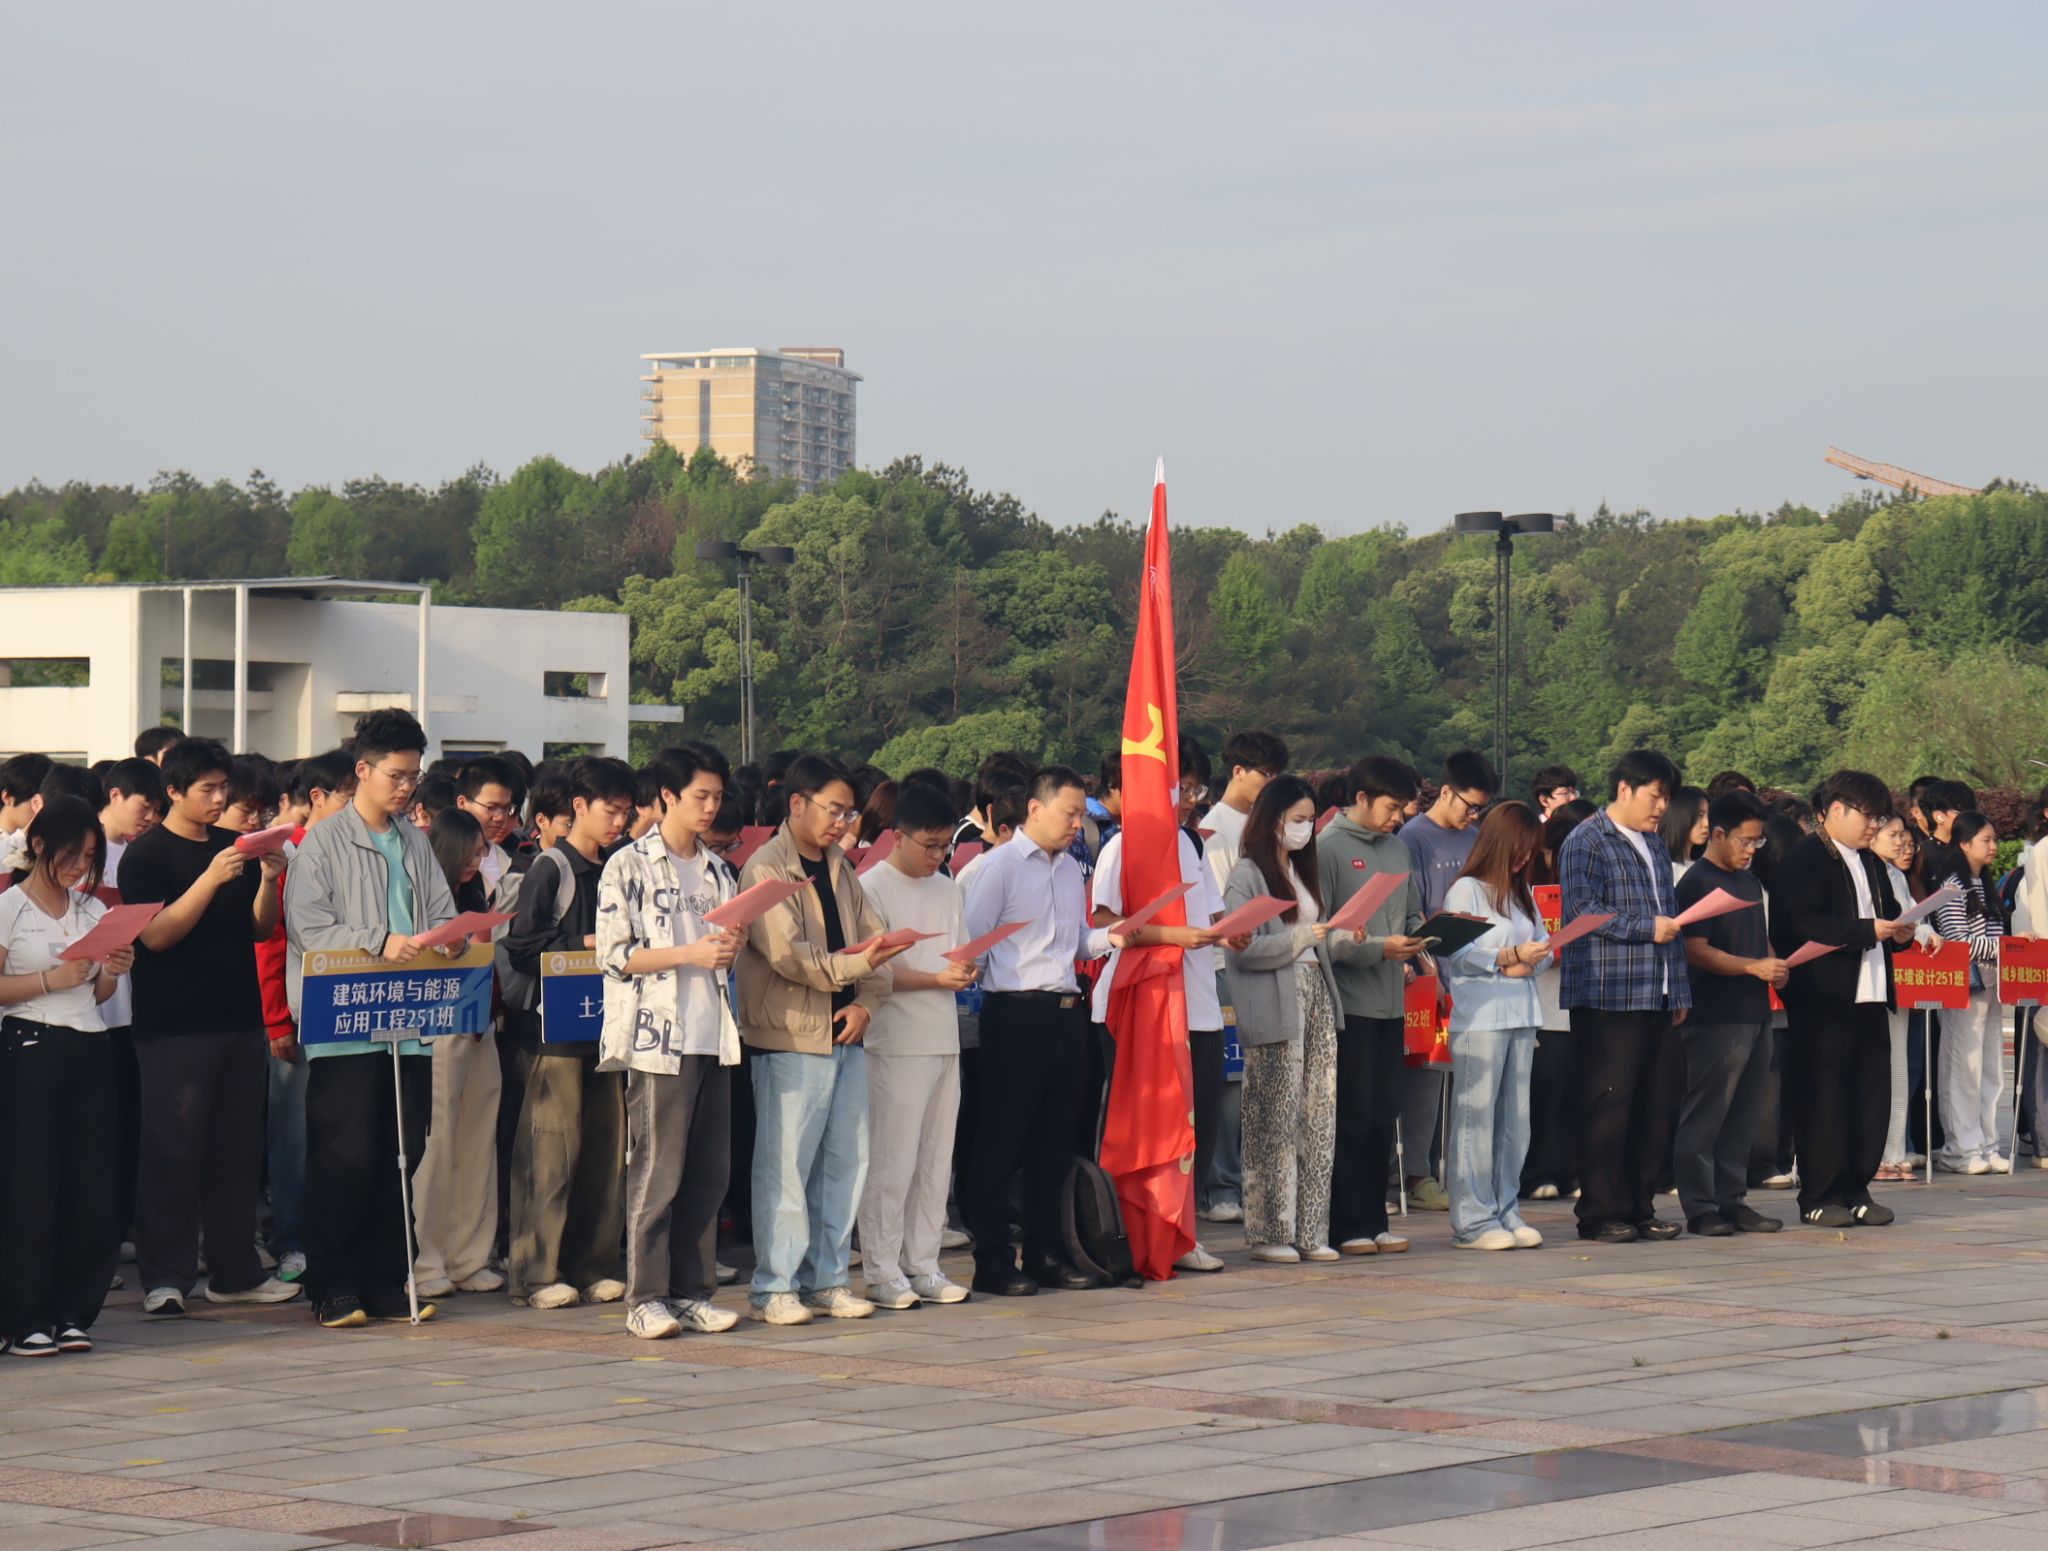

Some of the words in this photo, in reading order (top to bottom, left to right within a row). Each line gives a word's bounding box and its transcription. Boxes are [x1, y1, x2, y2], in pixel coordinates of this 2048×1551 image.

[1894, 968, 1965, 987] 环境设计251班
[2001, 965, 2048, 984] 城乡规划251
[332, 977, 461, 1007] 建筑环境与能源
[334, 1005, 455, 1035] 应用工程251班
